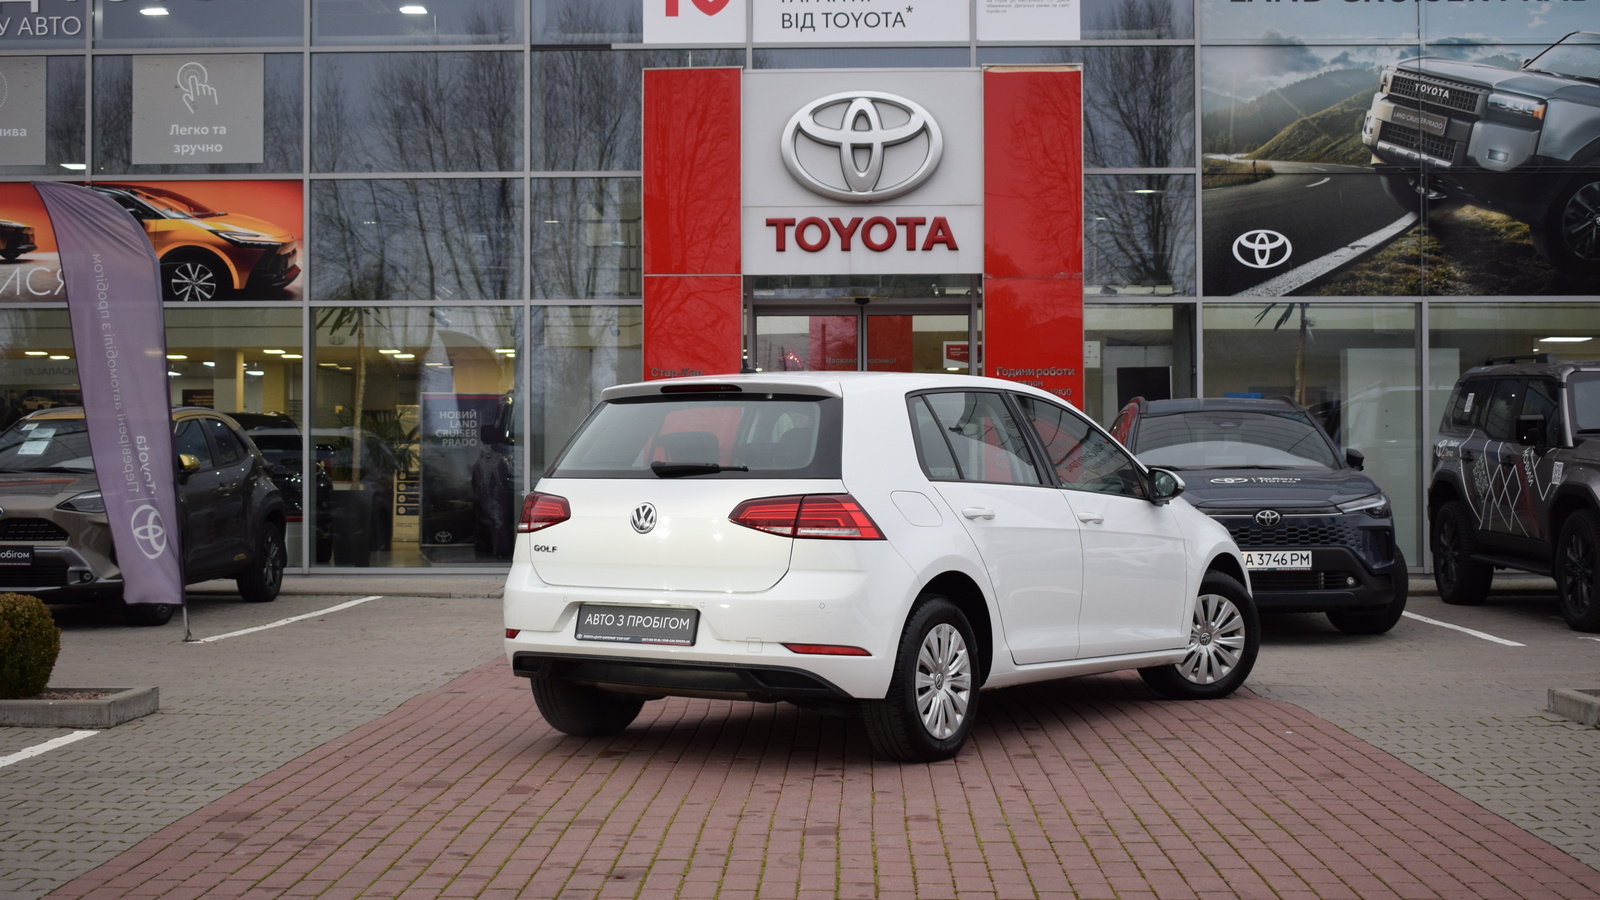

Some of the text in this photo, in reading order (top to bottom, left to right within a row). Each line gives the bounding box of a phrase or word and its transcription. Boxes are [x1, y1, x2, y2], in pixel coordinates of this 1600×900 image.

[18, 16, 82, 36] АВТО
[781, 13, 816, 32] ВІД
[1415, 83, 1449, 99] TOYOTA
[1406, 115, 1427, 124] CRUISER
[1427, 120, 1443, 129] PRADO
[0, 128, 27, 137] ива
[169, 124, 226, 136] Легко та
[173, 142, 223, 156] зручно
[766, 216, 959, 252] TOYOTA
[996, 366, 1074, 378] Години роботи
[440, 409, 477, 418] НОВИЙ
[450, 420, 477, 428] LAND
[436, 429, 478, 438] CRUISER
[442, 438, 478, 446] PRADO
[534, 544, 558, 553] GOLF
[1258, 553, 1288, 566] 3746
[585, 614, 615, 626] АВТО
[626, 615, 690, 630] ПРОБІГОМ
